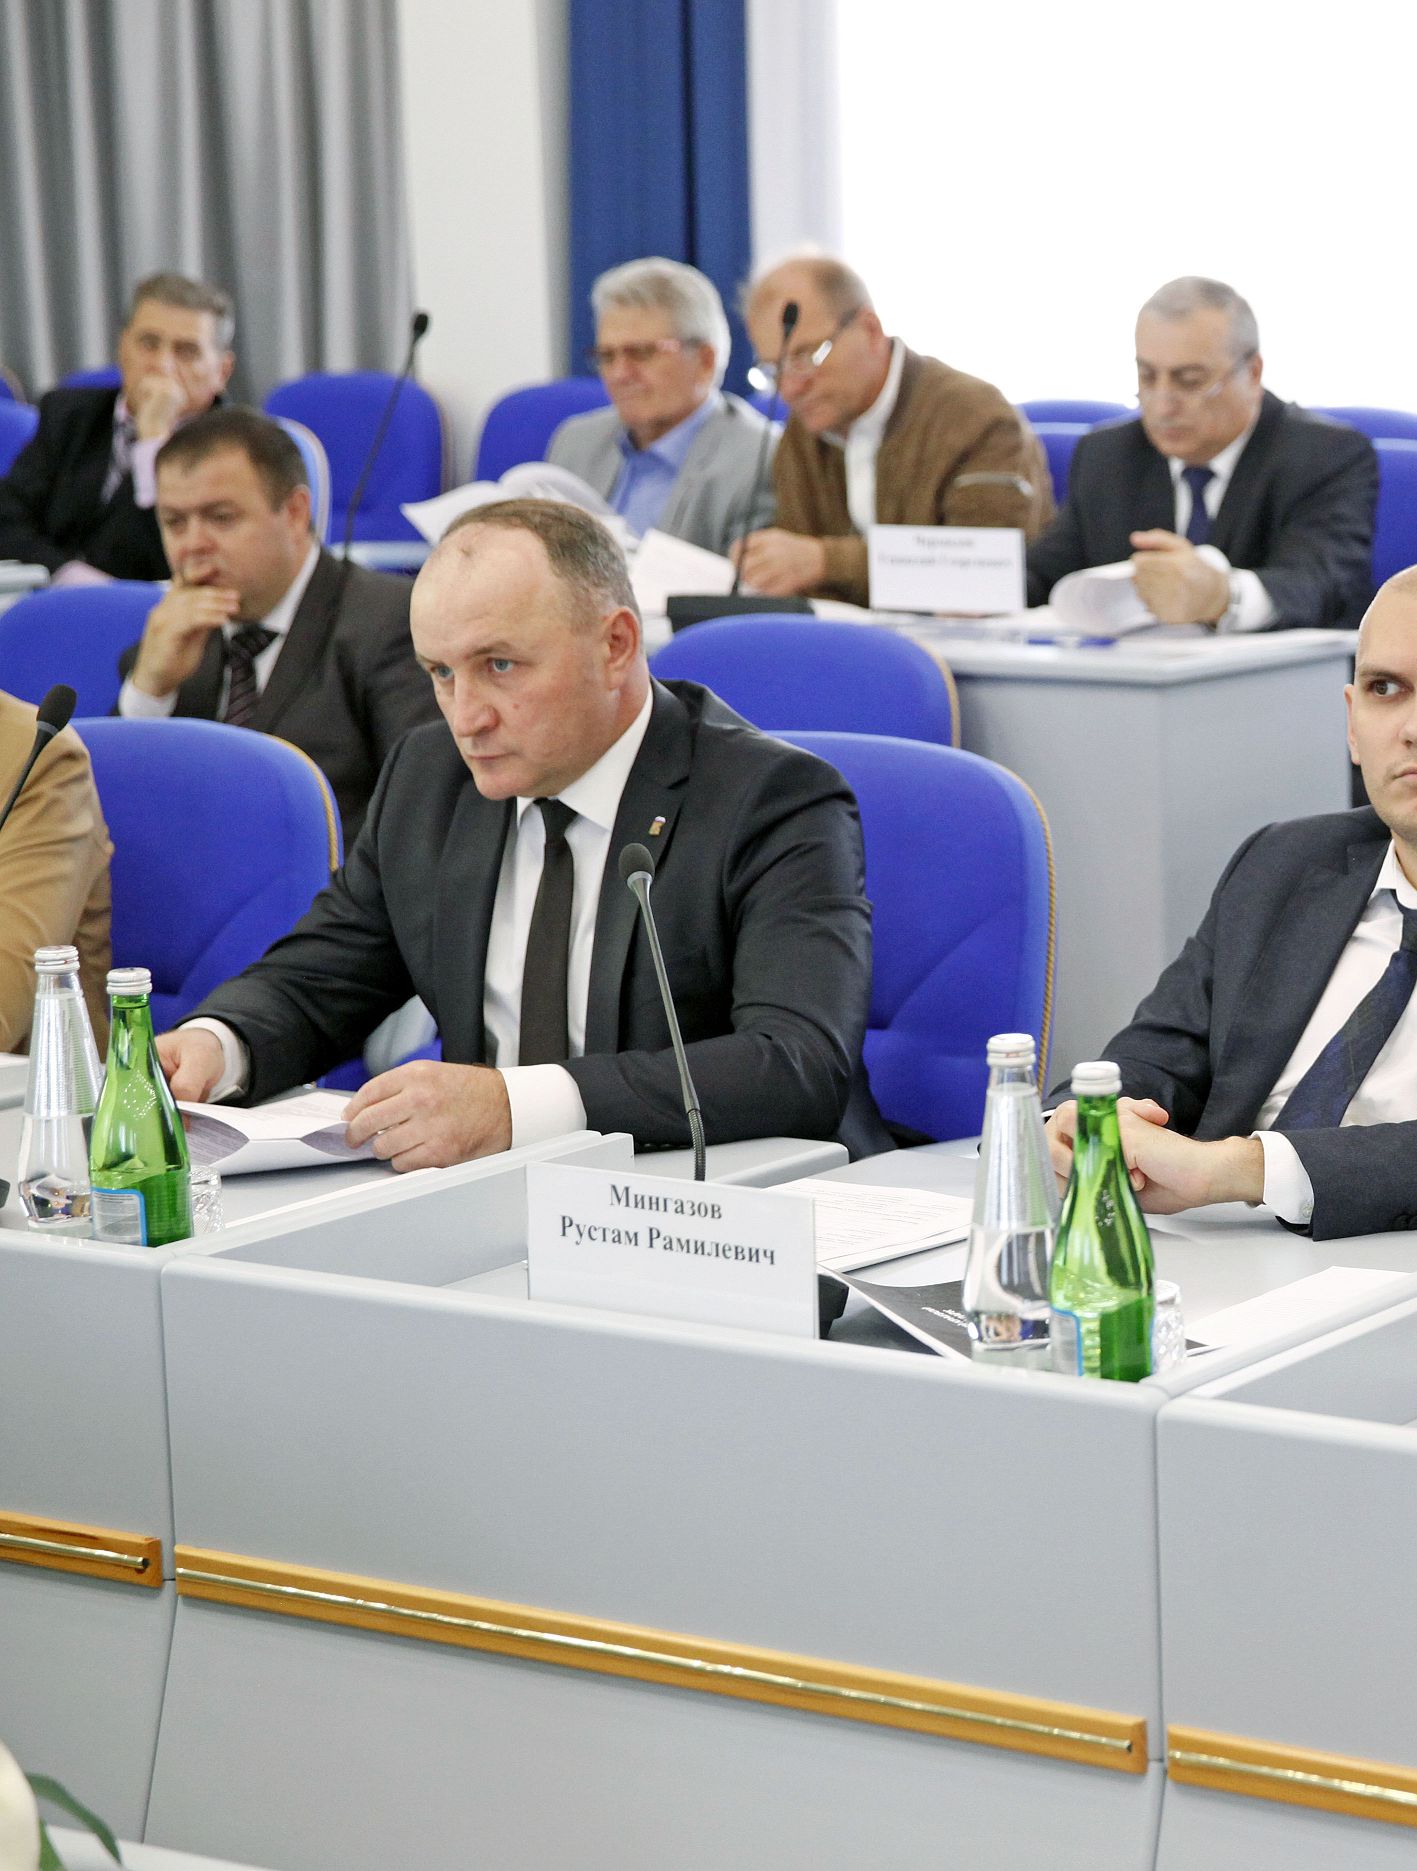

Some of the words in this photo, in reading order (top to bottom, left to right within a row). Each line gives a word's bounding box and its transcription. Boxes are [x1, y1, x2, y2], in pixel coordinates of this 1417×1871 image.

[609, 1184, 722, 1219] Мингазов
[560, 1215, 639, 1246] Рустам
[648, 1227, 775, 1265] Рамилевич
